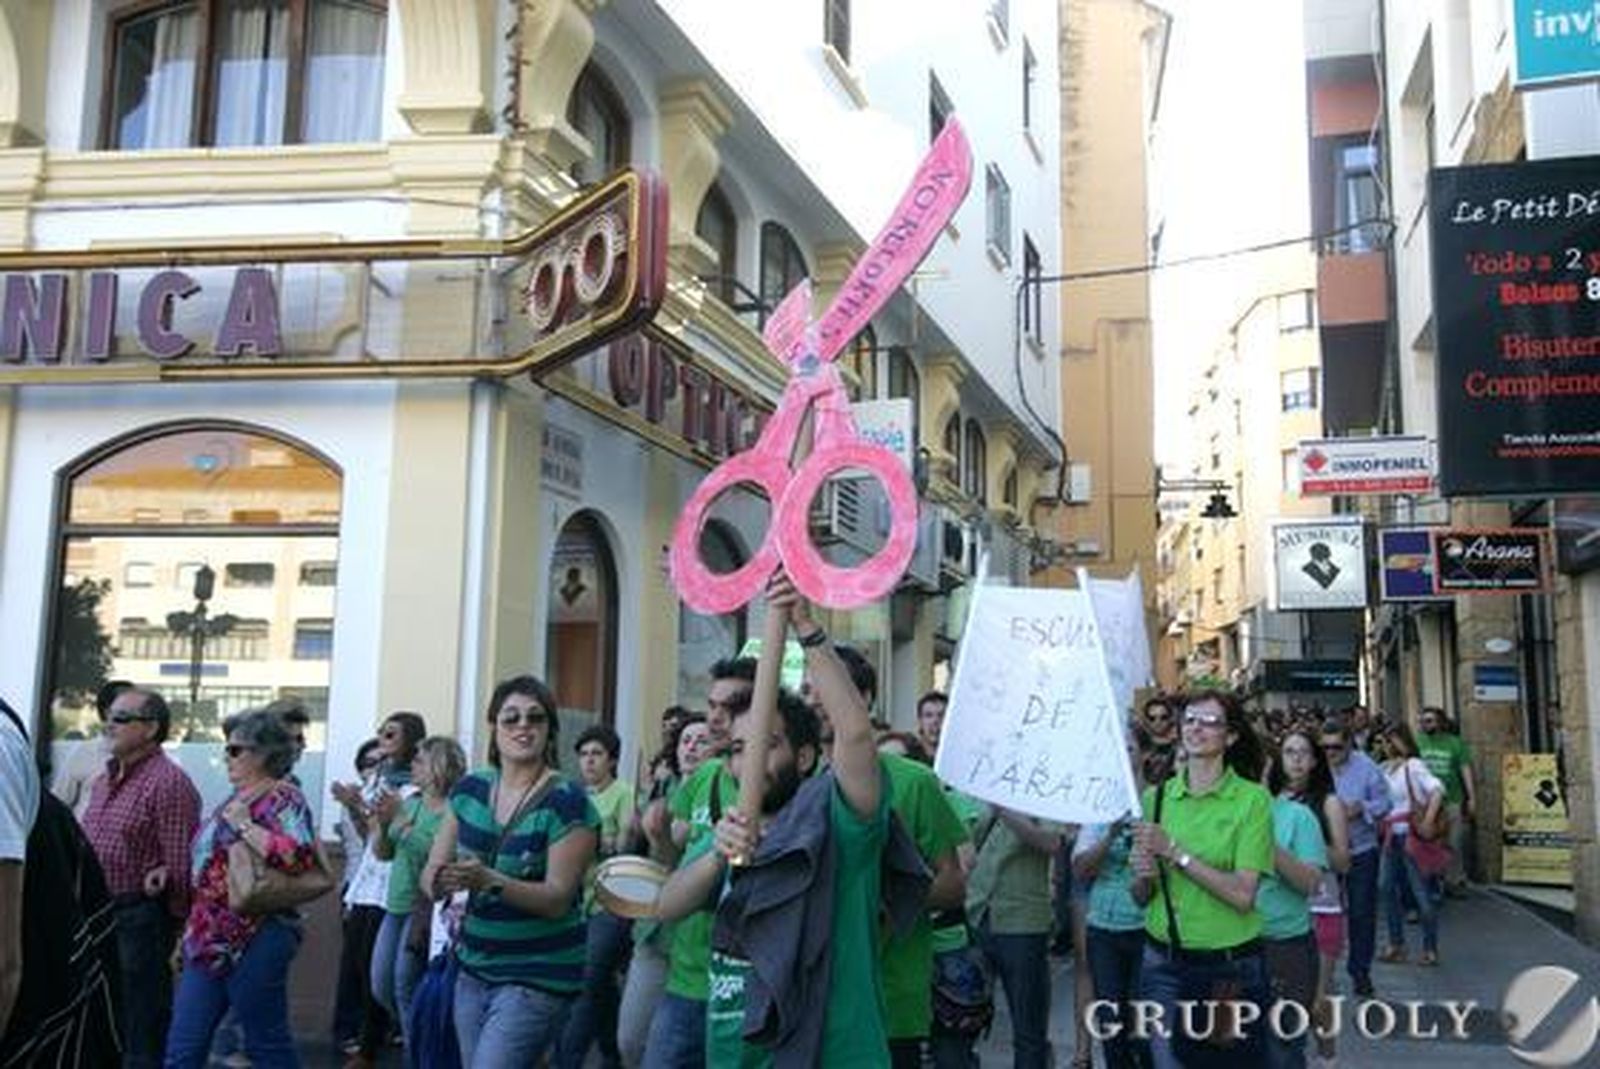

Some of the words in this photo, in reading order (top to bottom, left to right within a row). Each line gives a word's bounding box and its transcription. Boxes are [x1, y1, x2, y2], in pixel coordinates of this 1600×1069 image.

[1452, 202, 1487, 224] Le
[1490, 195, 1561, 225] Petit
[1465, 252, 1533, 275] Todo
[1538, 255, 1553, 270] a
[1565, 248, 1583, 270] 2
[2, 268, 285, 361] NICA
[1331, 457, 1429, 474] INMOPENIEL
